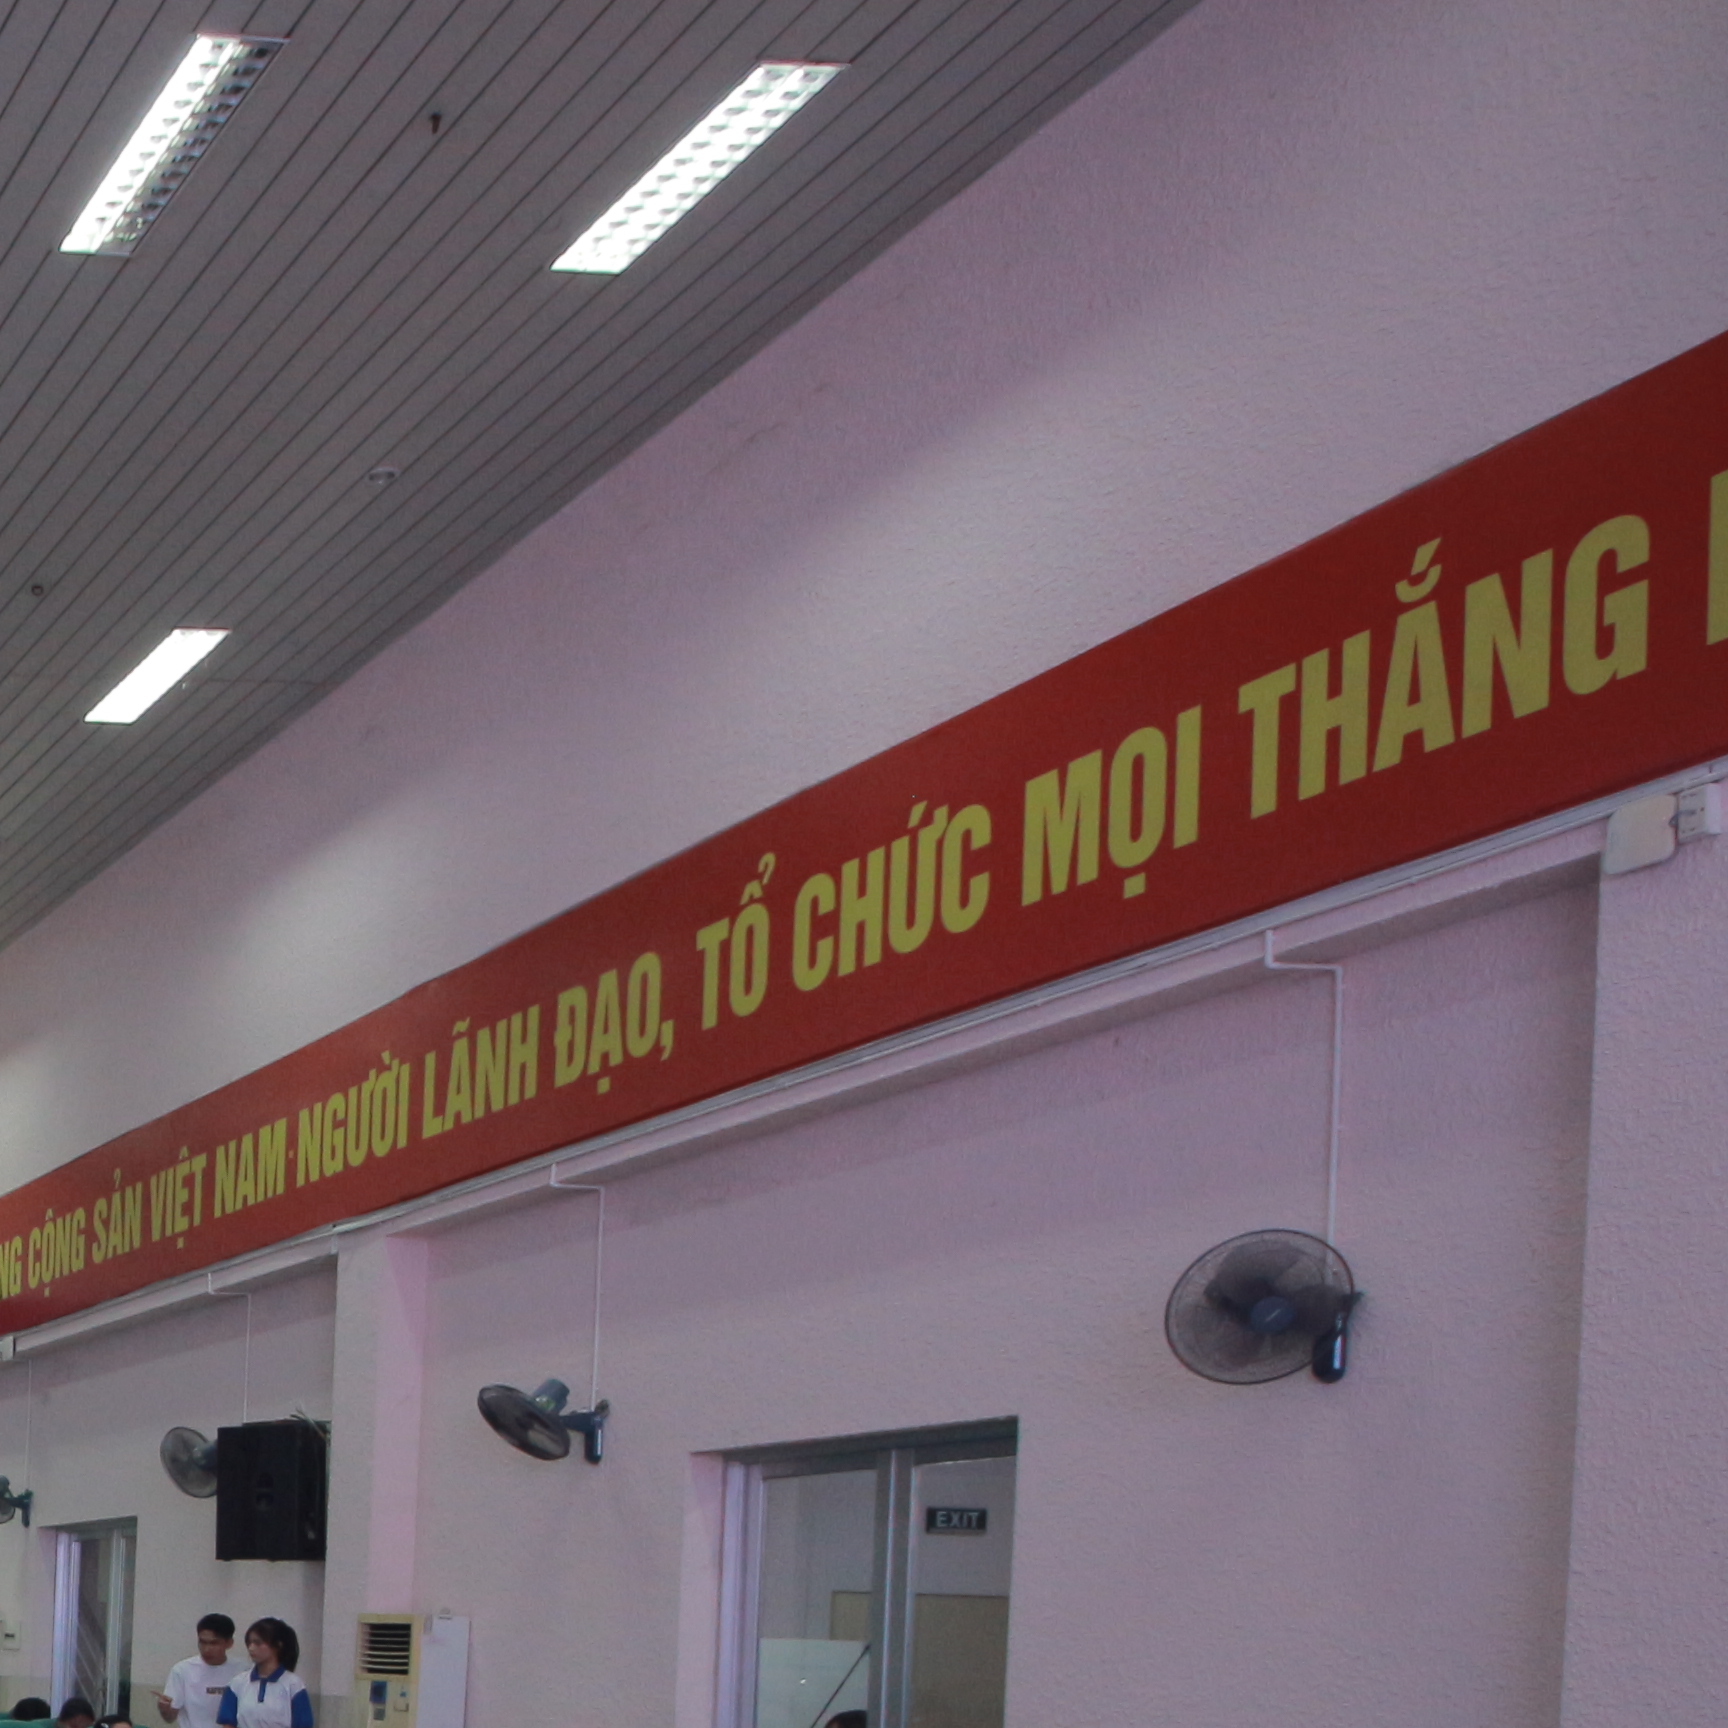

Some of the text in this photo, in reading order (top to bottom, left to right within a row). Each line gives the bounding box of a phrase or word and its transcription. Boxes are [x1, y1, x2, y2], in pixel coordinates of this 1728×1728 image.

[27, 1207, 87, 1298] CỘNG
[92, 1168, 144, 1264] SẢN
[149, 1147, 208, 1250] VIỆT
[213, 1117, 288, 1219] NAM
[296, 1050, 411, 1188] NGƯỜI
[421, 1004, 541, 1139] LÃNH
[554, 952, 675, 1096] ĐẠO,
[696, 852, 776, 1030] TỔ
[792, 801, 992, 992] CHỨC
[1021, 705, 1202, 907] MỌI
[1237, 515, 1650, 819] THẮNG
[936, 1511, 980, 1528] EXIT
